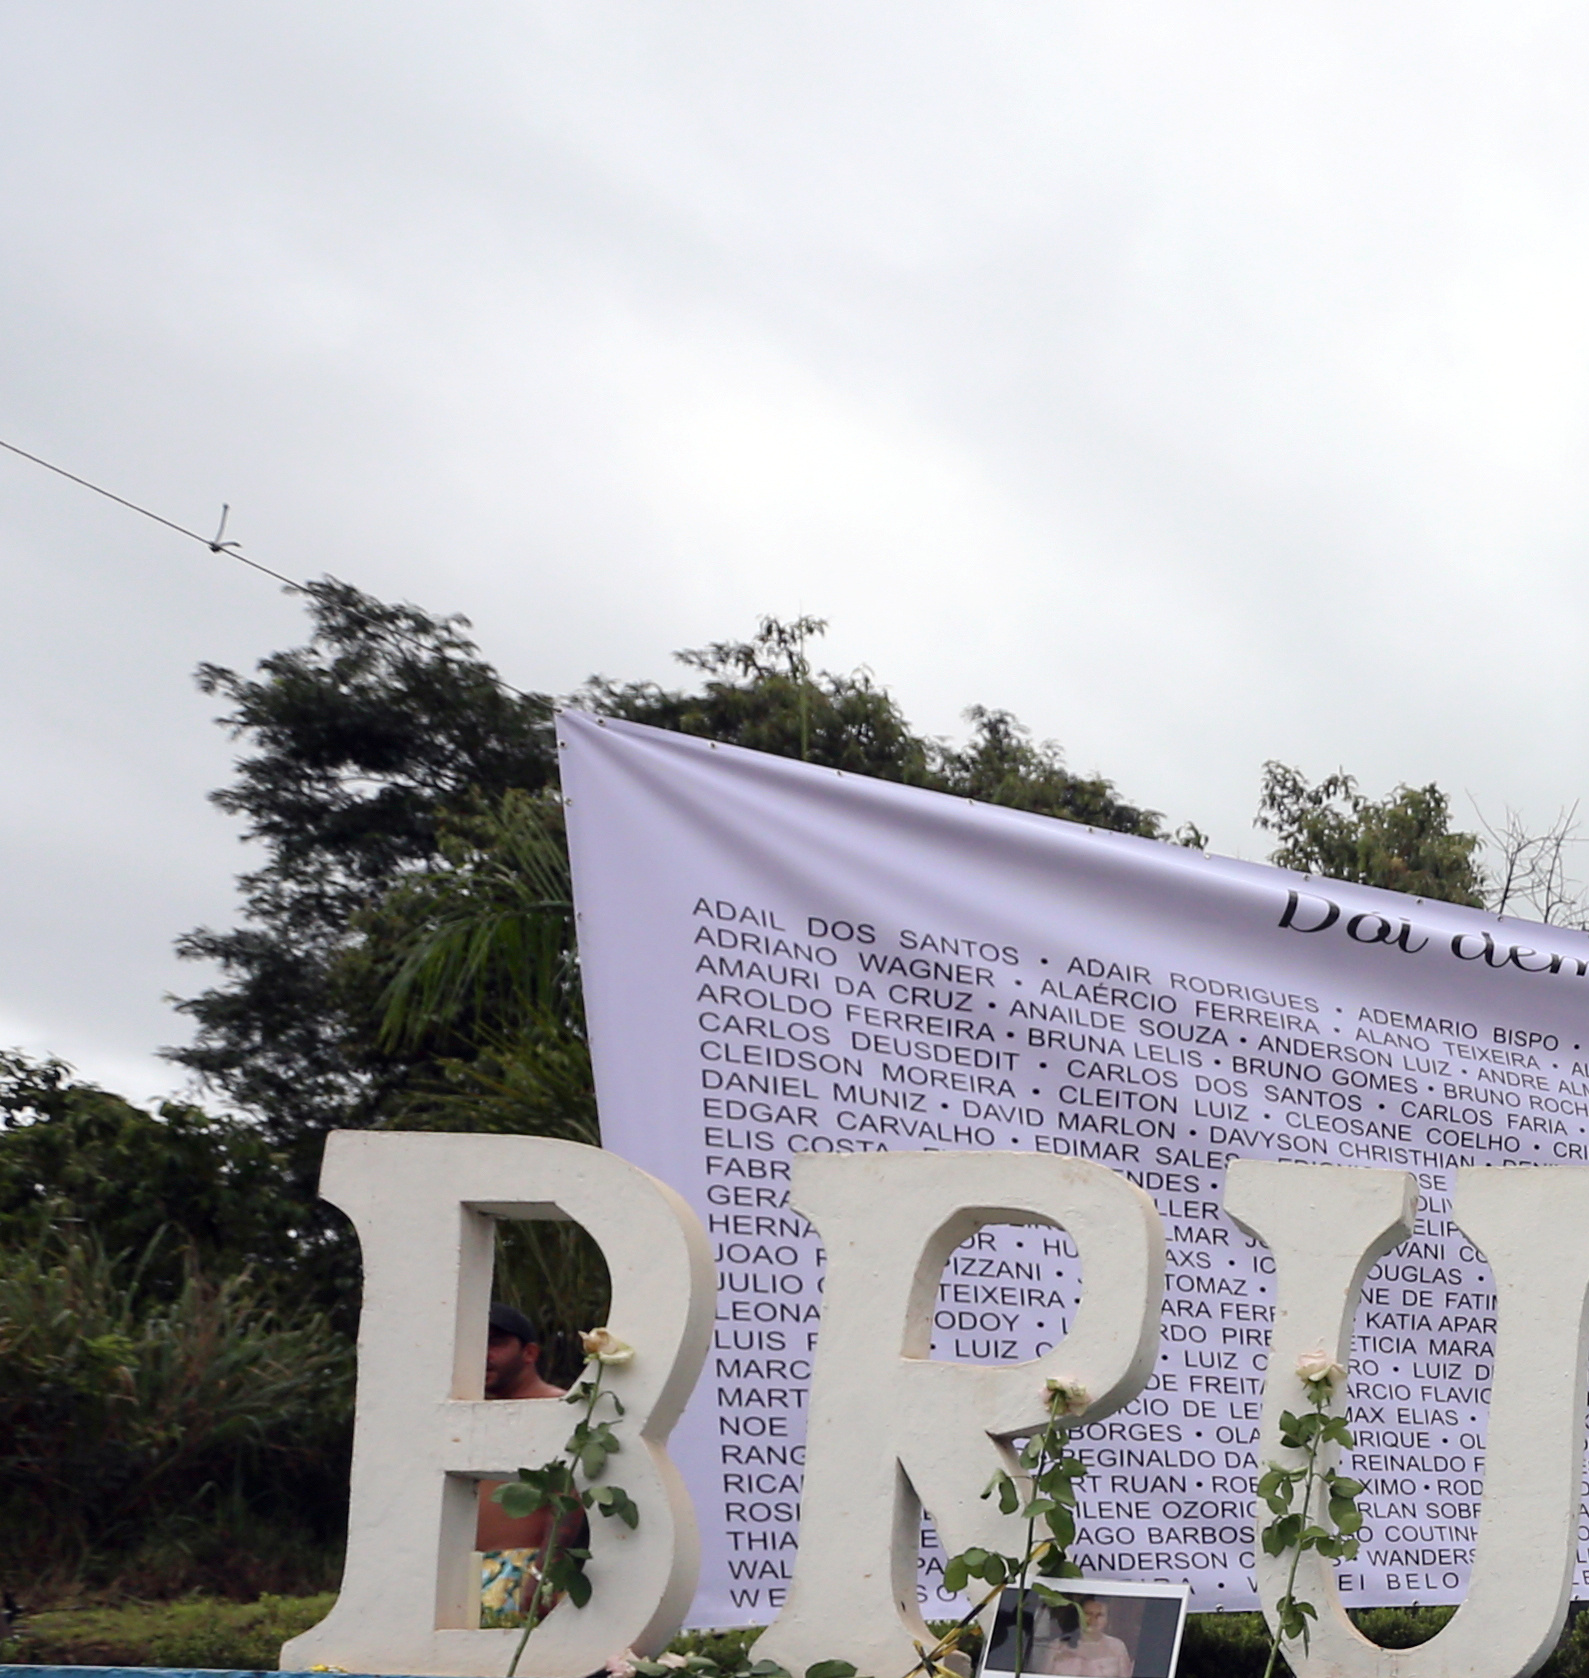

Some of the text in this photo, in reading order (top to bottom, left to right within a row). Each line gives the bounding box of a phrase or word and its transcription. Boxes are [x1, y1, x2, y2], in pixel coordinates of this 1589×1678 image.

[692, 897, 785, 931] ADAIL
[808, 917, 876, 945] DOS
[899, 929, 1019, 966] SANTOS
[1067, 956, 1152, 985] ADAIR
[1170, 972, 1319, 1013] RODRIGUES
[1358, 1007, 1478, 1039] ADEMARIO
[1493, 1027, 1559, 1052] BISPO
[694, 926, 837, 967] ADRIANO
[858, 952, 995, 988] WAGNER
[1040, 979, 1177, 1014] ALAÉRCIO
[1195, 1000, 1320, 1035] FERREIRA
[1355, 1027, 1430, 1052] ALANO
[1442, 1041, 1540, 1070] TEIXEIRA
[695, 954, 819, 990] AMAURI
[835, 976, 876, 1000] DA
[888, 984, 973, 1013] CRUZ
[1009, 999, 1126, 1033] ANAILDE
[1139, 1018, 1229, 1047] SOUZA
[1257, 1034, 1392, 1068] ANDERSON
[1403, 1055, 1452, 1077] LUIZ
[1477, 1067, 1550, 1092] ANDRE
[696, 983, 832, 1019] AROLDO
[846, 1004, 995, 1042] FERREIRA
[1028, 1027, 1125, 1057] BRUNA
[1134, 1042, 1203, 1068] LELIS
[1232, 1055, 1321, 1083] BRUNO
[1332, 1068, 1418, 1095] GOMES
[1444, 1083, 1521, 1107] BRUNO
[698, 1012, 830, 1045] CARLOS
[851, 1031, 1020, 1071] DEUSDEDIT
[1067, 1059, 1178, 1088] CARLOS
[1195, 1075, 1248, 1098] DOS
[1264, 1084, 1362, 1112] SANTOS
[1401, 1101, 1493, 1127] CARLOS
[1507, 1113, 1568, 1136] FARIA
[700, 1040, 863, 1077] CLEIDSON
[882, 1062, 1016, 1098] MOREIRA
[1059, 1085, 1177, 1114] CLEITON
[1195, 1099, 1249, 1122] LUIZ
[1286, 1111, 1412, 1142] CLEOSANE
[1426, 1127, 1520, 1153] COELHO
[702, 1069, 1482, 1169] DANIEL MUNIZ DAVID MARLON DAVYSON CHRISTHIAN
[703, 1097, 995, 1147] EDGAR CARVALHO
[955, 1338, 1019, 1359] LUIZ
[1366, 1311, 1432, 1331] KATIA
[719, 1416, 788, 1437] NOE
[1397, 1408, 1459, 1426] ELIAS
[1352, 1454, 1466, 1473] REINALDO
[1386, 1572, 1459, 1590] BELO
